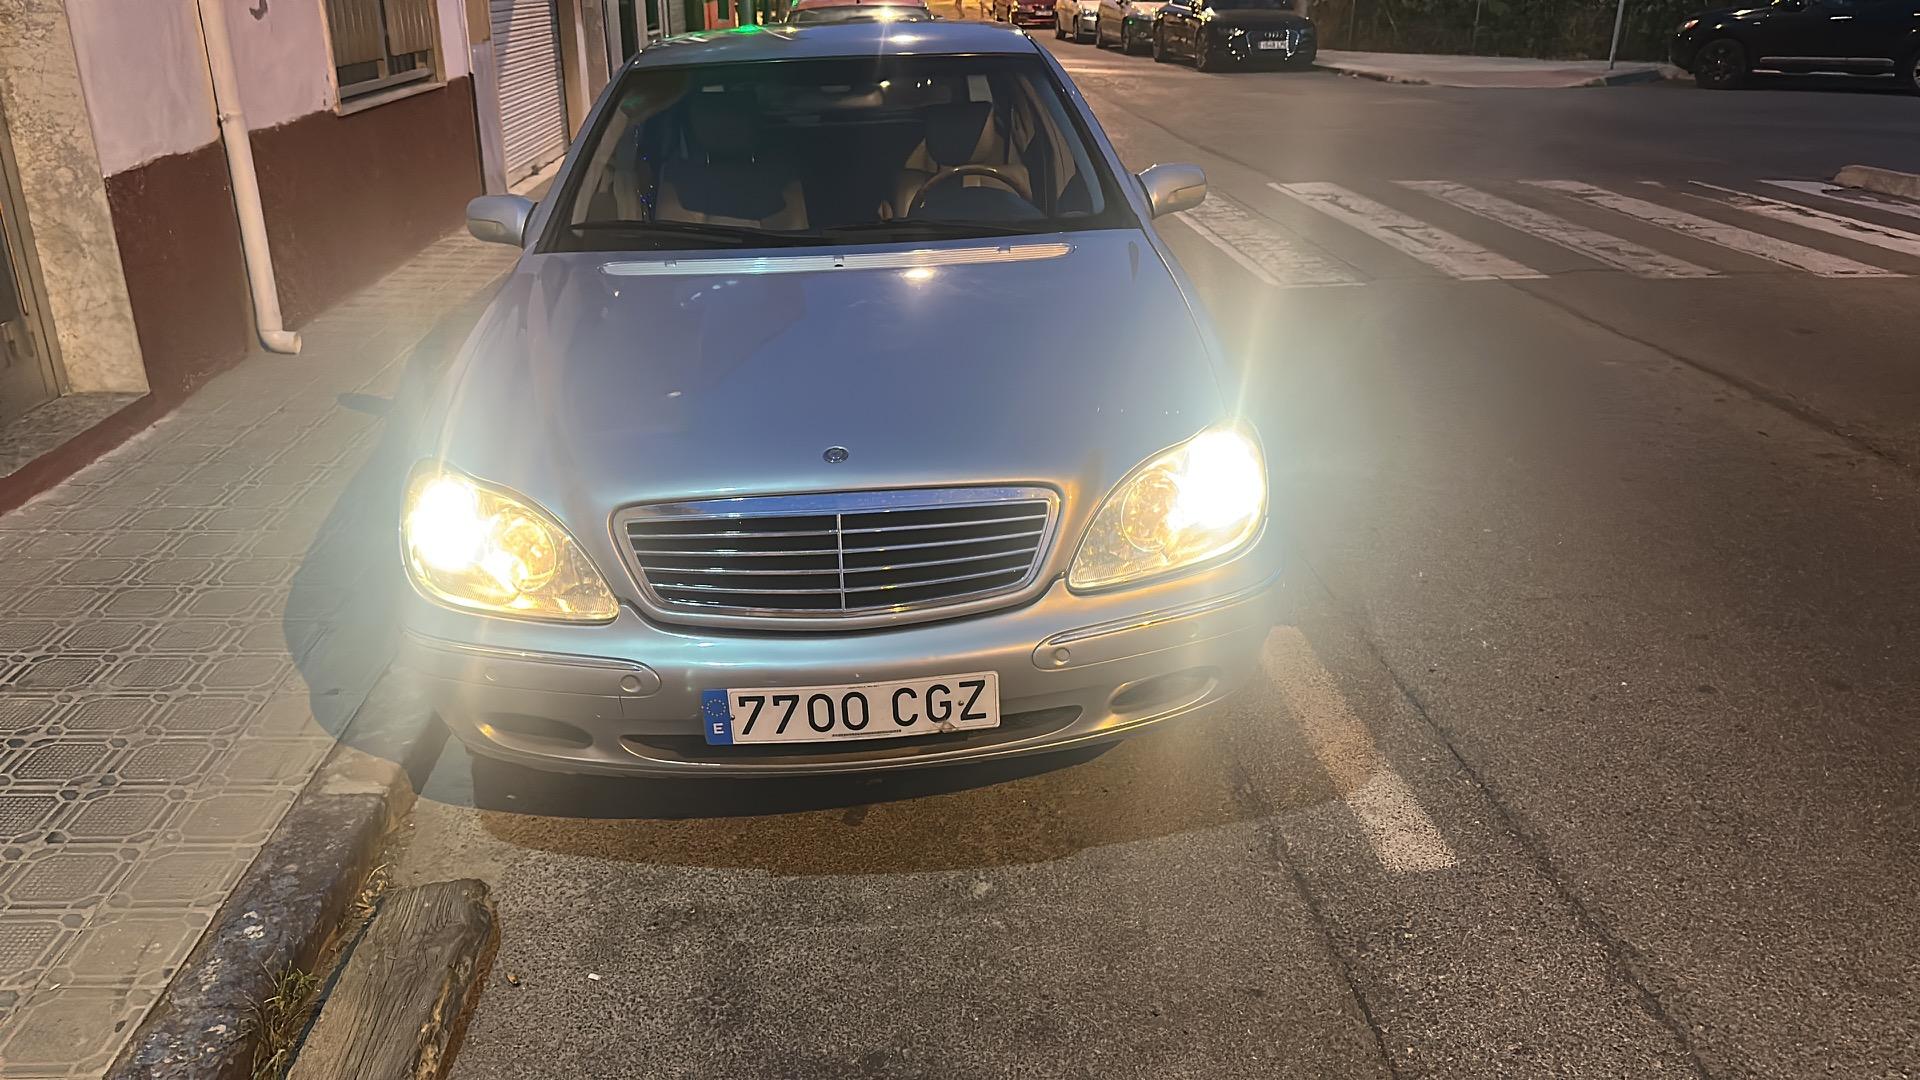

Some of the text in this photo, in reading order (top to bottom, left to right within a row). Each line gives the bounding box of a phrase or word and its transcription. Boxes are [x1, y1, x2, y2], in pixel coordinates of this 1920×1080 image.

[738, 679, 987, 735] 7700 CGZ
[713, 722, 725, 735] E
